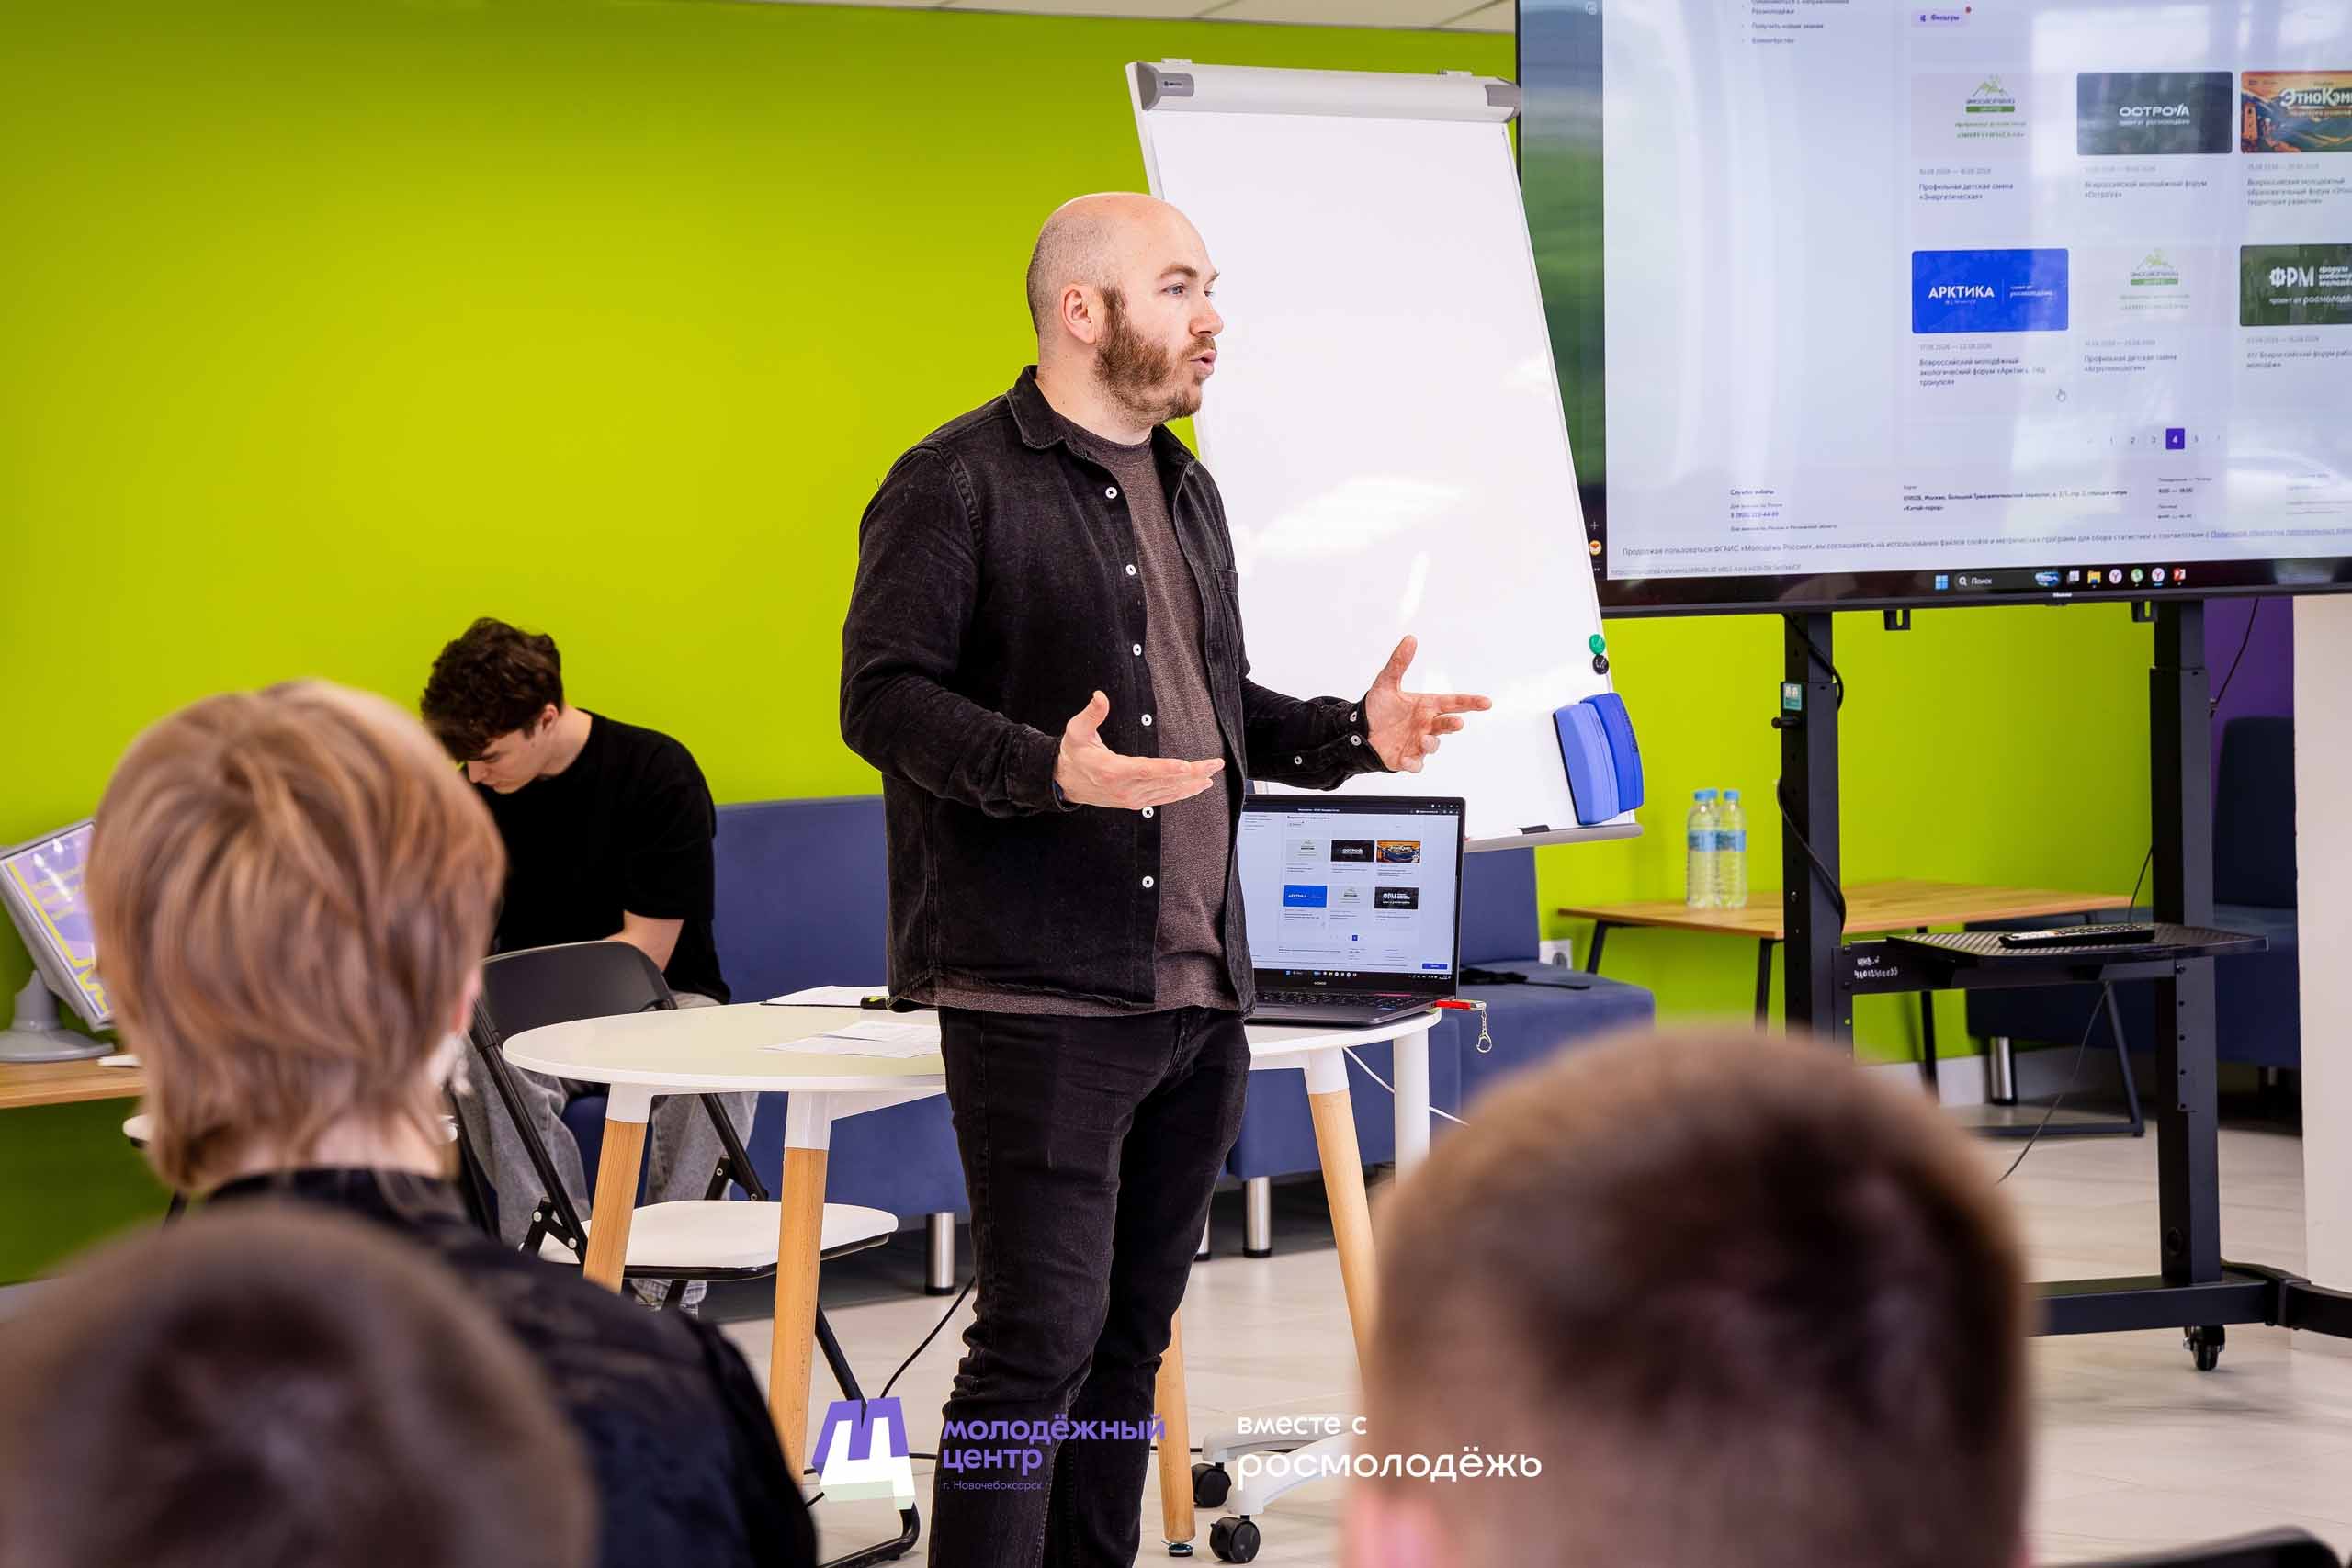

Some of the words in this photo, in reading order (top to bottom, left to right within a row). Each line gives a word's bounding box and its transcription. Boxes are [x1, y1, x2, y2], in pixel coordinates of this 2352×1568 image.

[2269, 266, 2315, 288] ФРМ
[1928, 285, 1995, 299] АРКТИКА
[2171, 434, 2178, 445] 4
[1971, 576, 1993, 587] Поиск
